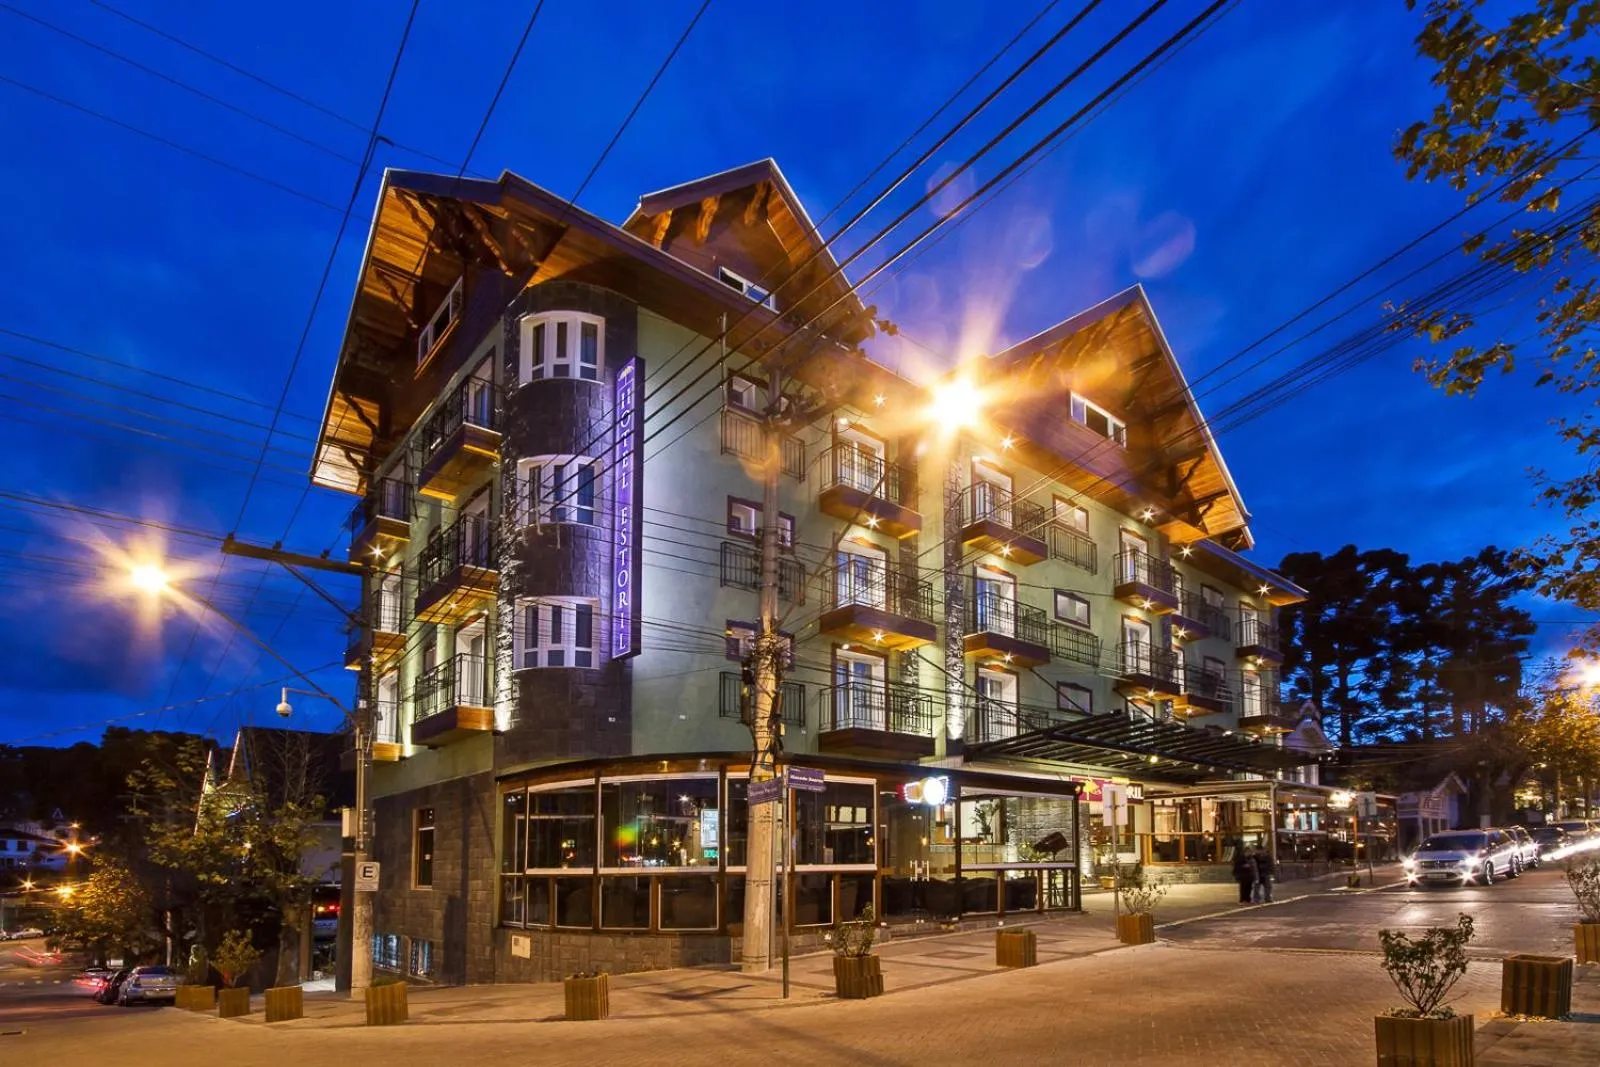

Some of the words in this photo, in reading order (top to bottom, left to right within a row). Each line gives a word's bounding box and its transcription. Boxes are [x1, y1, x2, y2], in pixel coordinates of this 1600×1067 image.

[620, 388, 632, 489] HOTEL
[617, 506, 630, 650] ESTORIL
[363, 866, 374, 877] E
